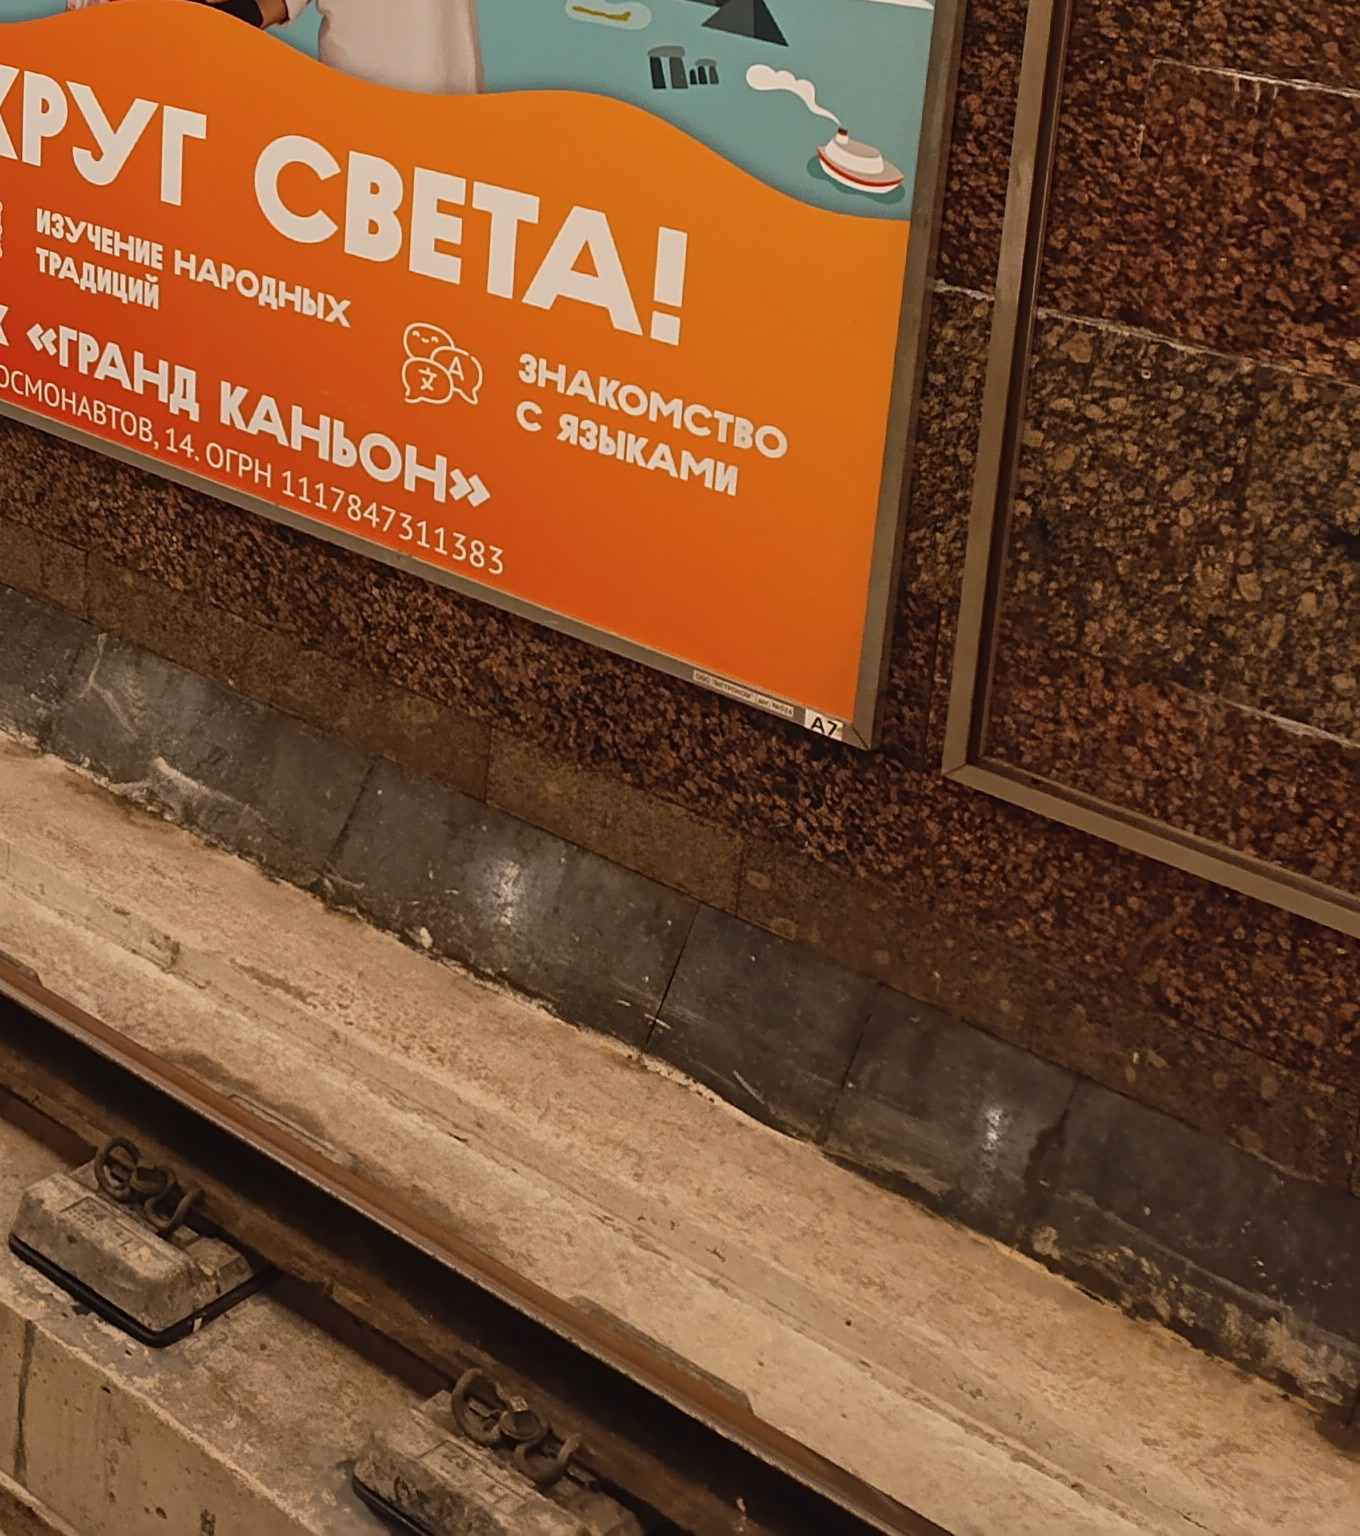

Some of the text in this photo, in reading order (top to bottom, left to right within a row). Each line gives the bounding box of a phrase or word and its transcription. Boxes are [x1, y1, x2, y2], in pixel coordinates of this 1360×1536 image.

[36, 207, 352, 328] ИЗУЧЕНИЕ НАРОДНЫХ
[36, 246, 160, 311] ТРАДИЦИЙ
[254, 134, 688, 346] СВЕТА!
[26, 322, 201, 422] «ГРАНД
[219, 379, 491, 508] КАНЬОН»
[515, 400, 739, 497] С ЯЗЫКАМИ
[518, 352, 789, 459] ЗНАКОМСТВО
[164, 424, 200, 464] 14.
[205, 441, 273, 489] ОГРН
[280, 469, 505, 576] 1117847311383
